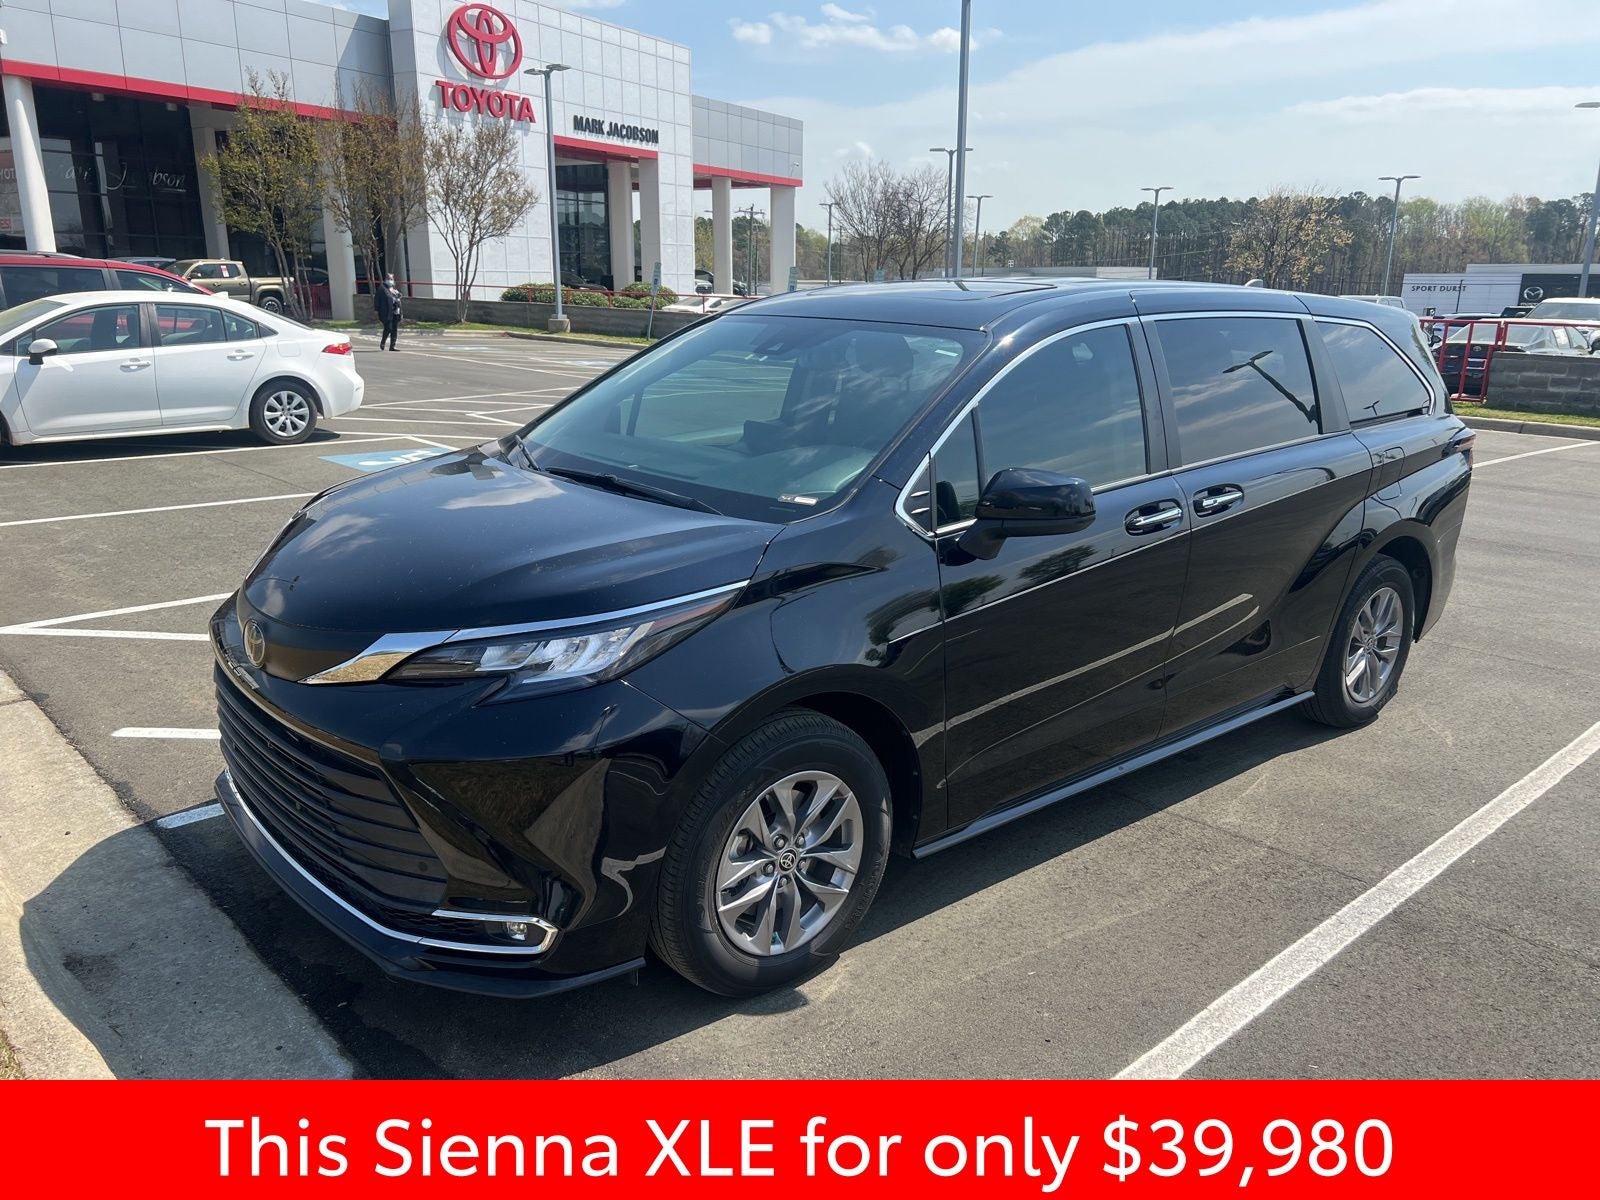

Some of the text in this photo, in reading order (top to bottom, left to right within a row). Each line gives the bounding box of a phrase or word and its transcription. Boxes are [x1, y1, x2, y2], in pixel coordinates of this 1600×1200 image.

[435, 80, 536, 123] TOYOTA
[573, 115, 659, 144] MARK JACOBSON
